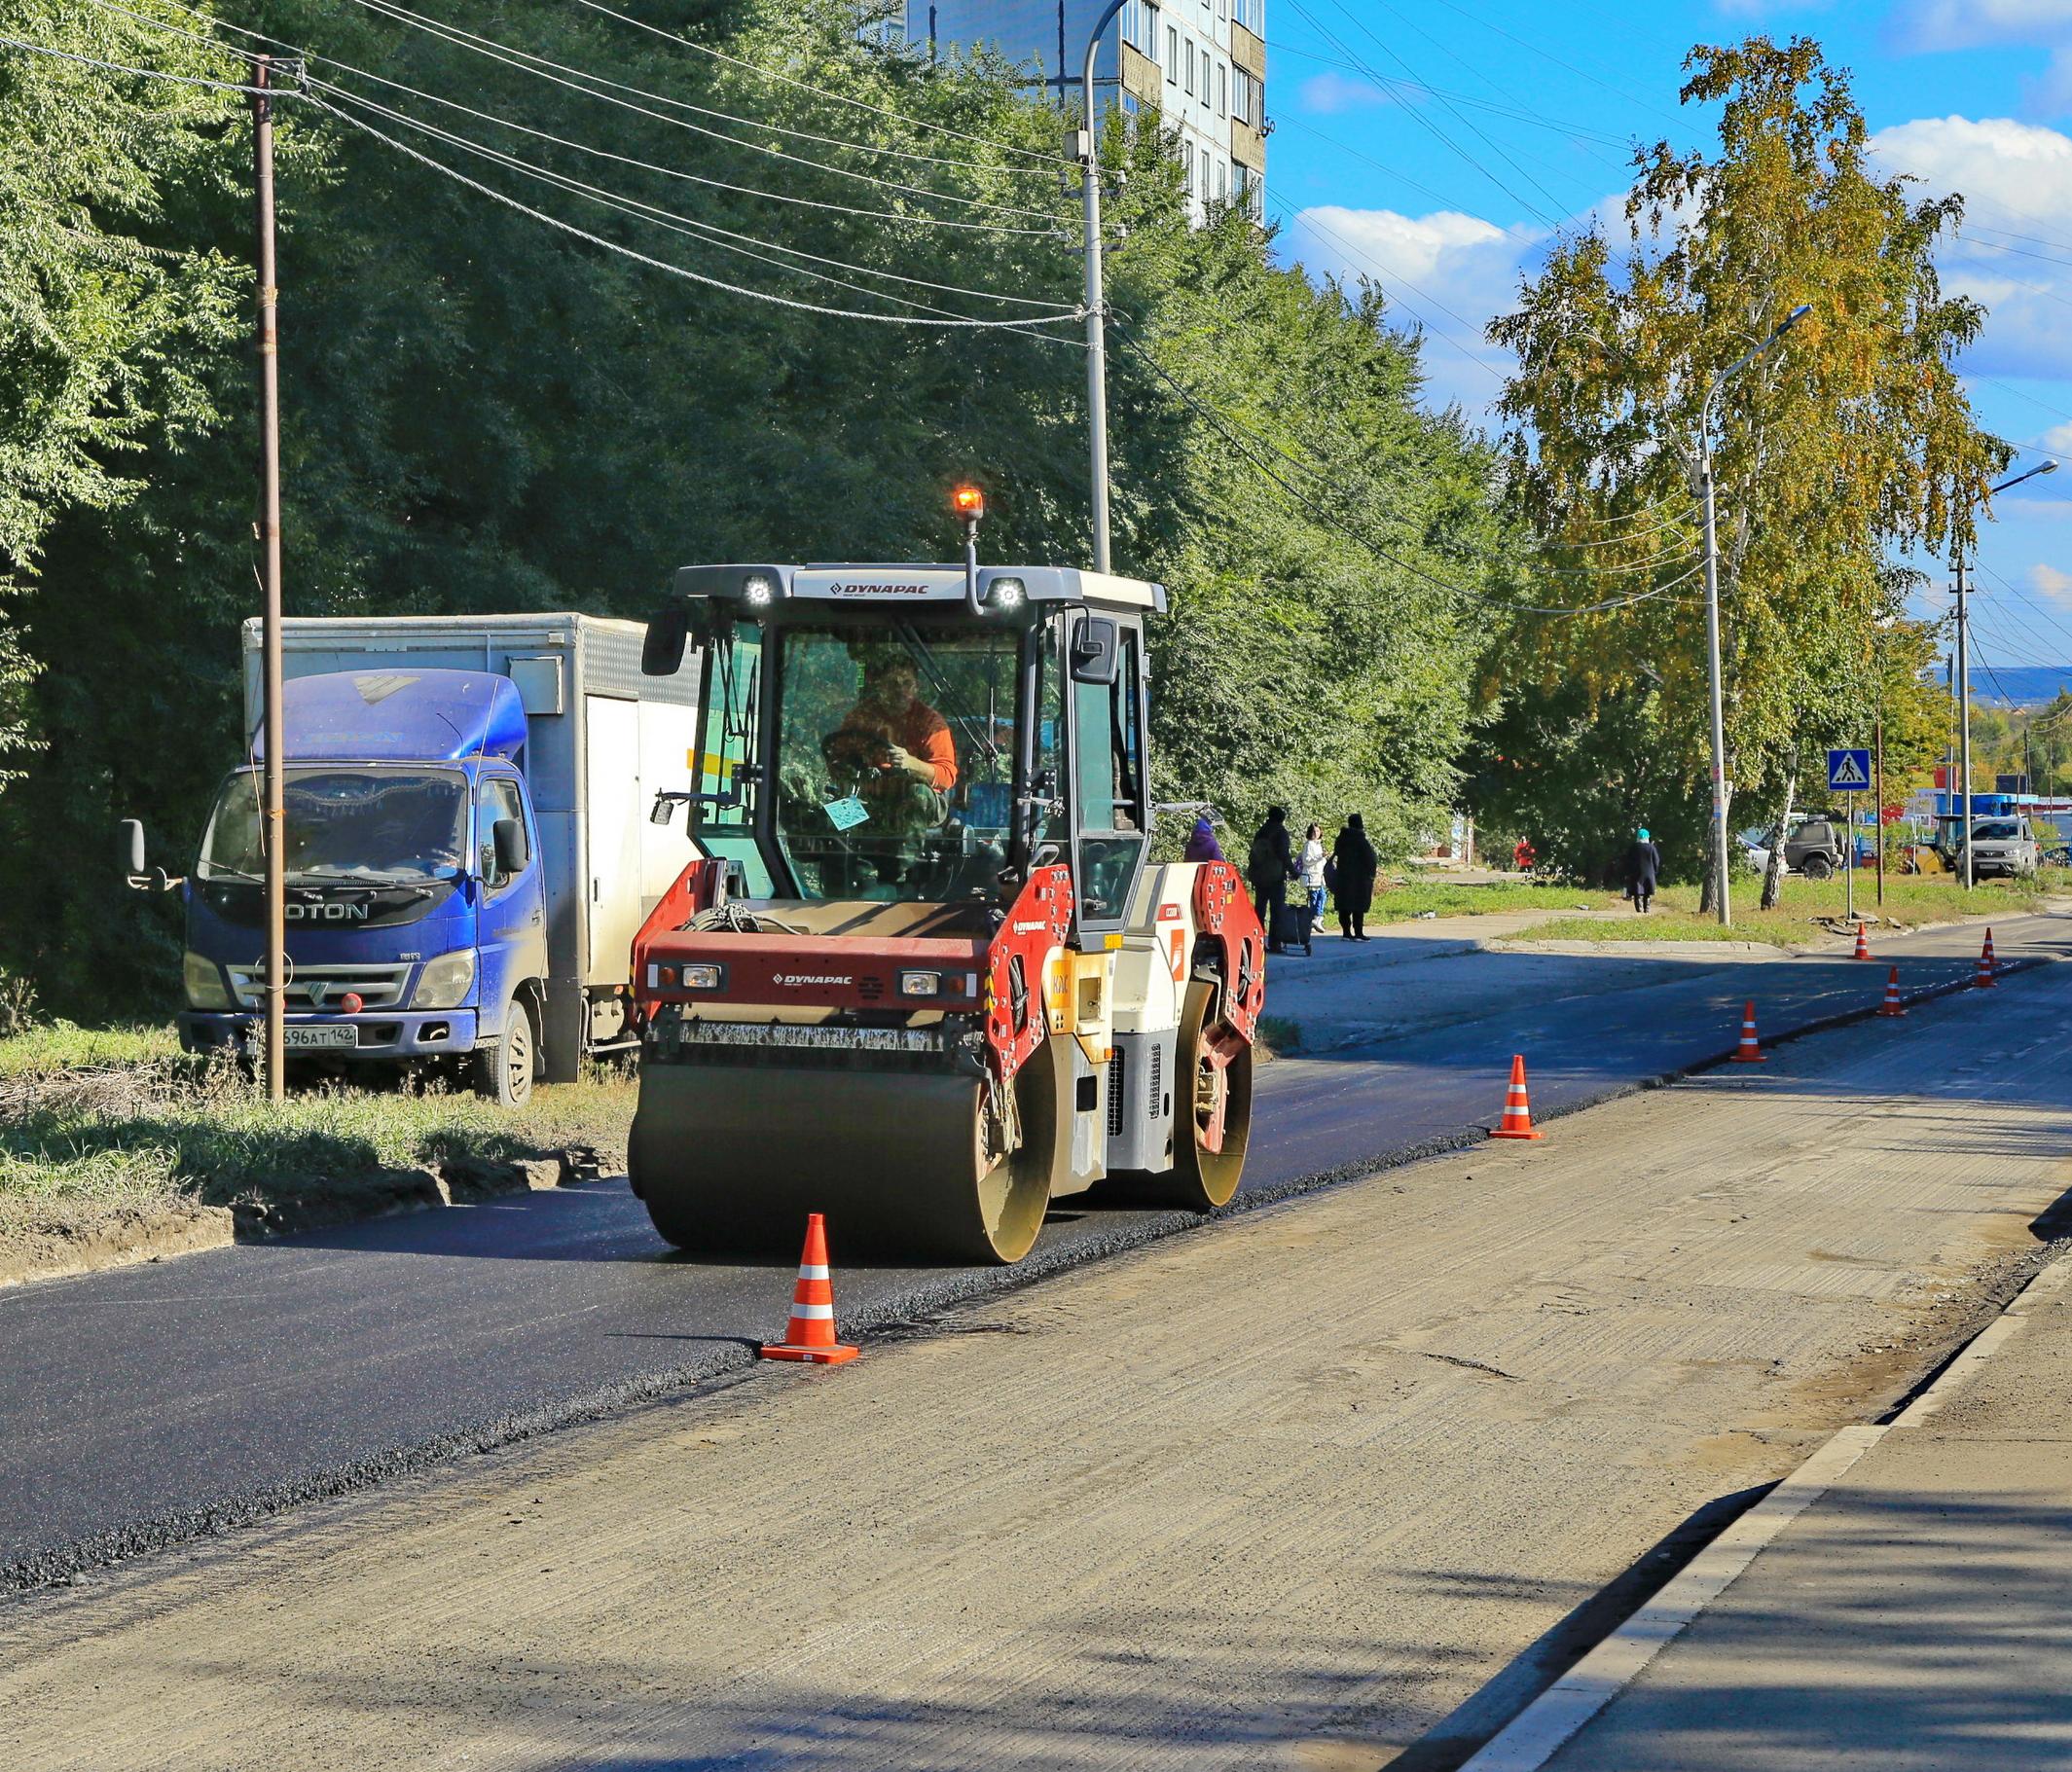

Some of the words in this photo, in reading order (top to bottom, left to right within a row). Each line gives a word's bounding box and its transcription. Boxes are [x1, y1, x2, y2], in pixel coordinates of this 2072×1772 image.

[844, 585, 929, 595] DYNAPAC
[283, 903, 368, 920] OTON
[783, 975, 853, 985] DYNAPAC
